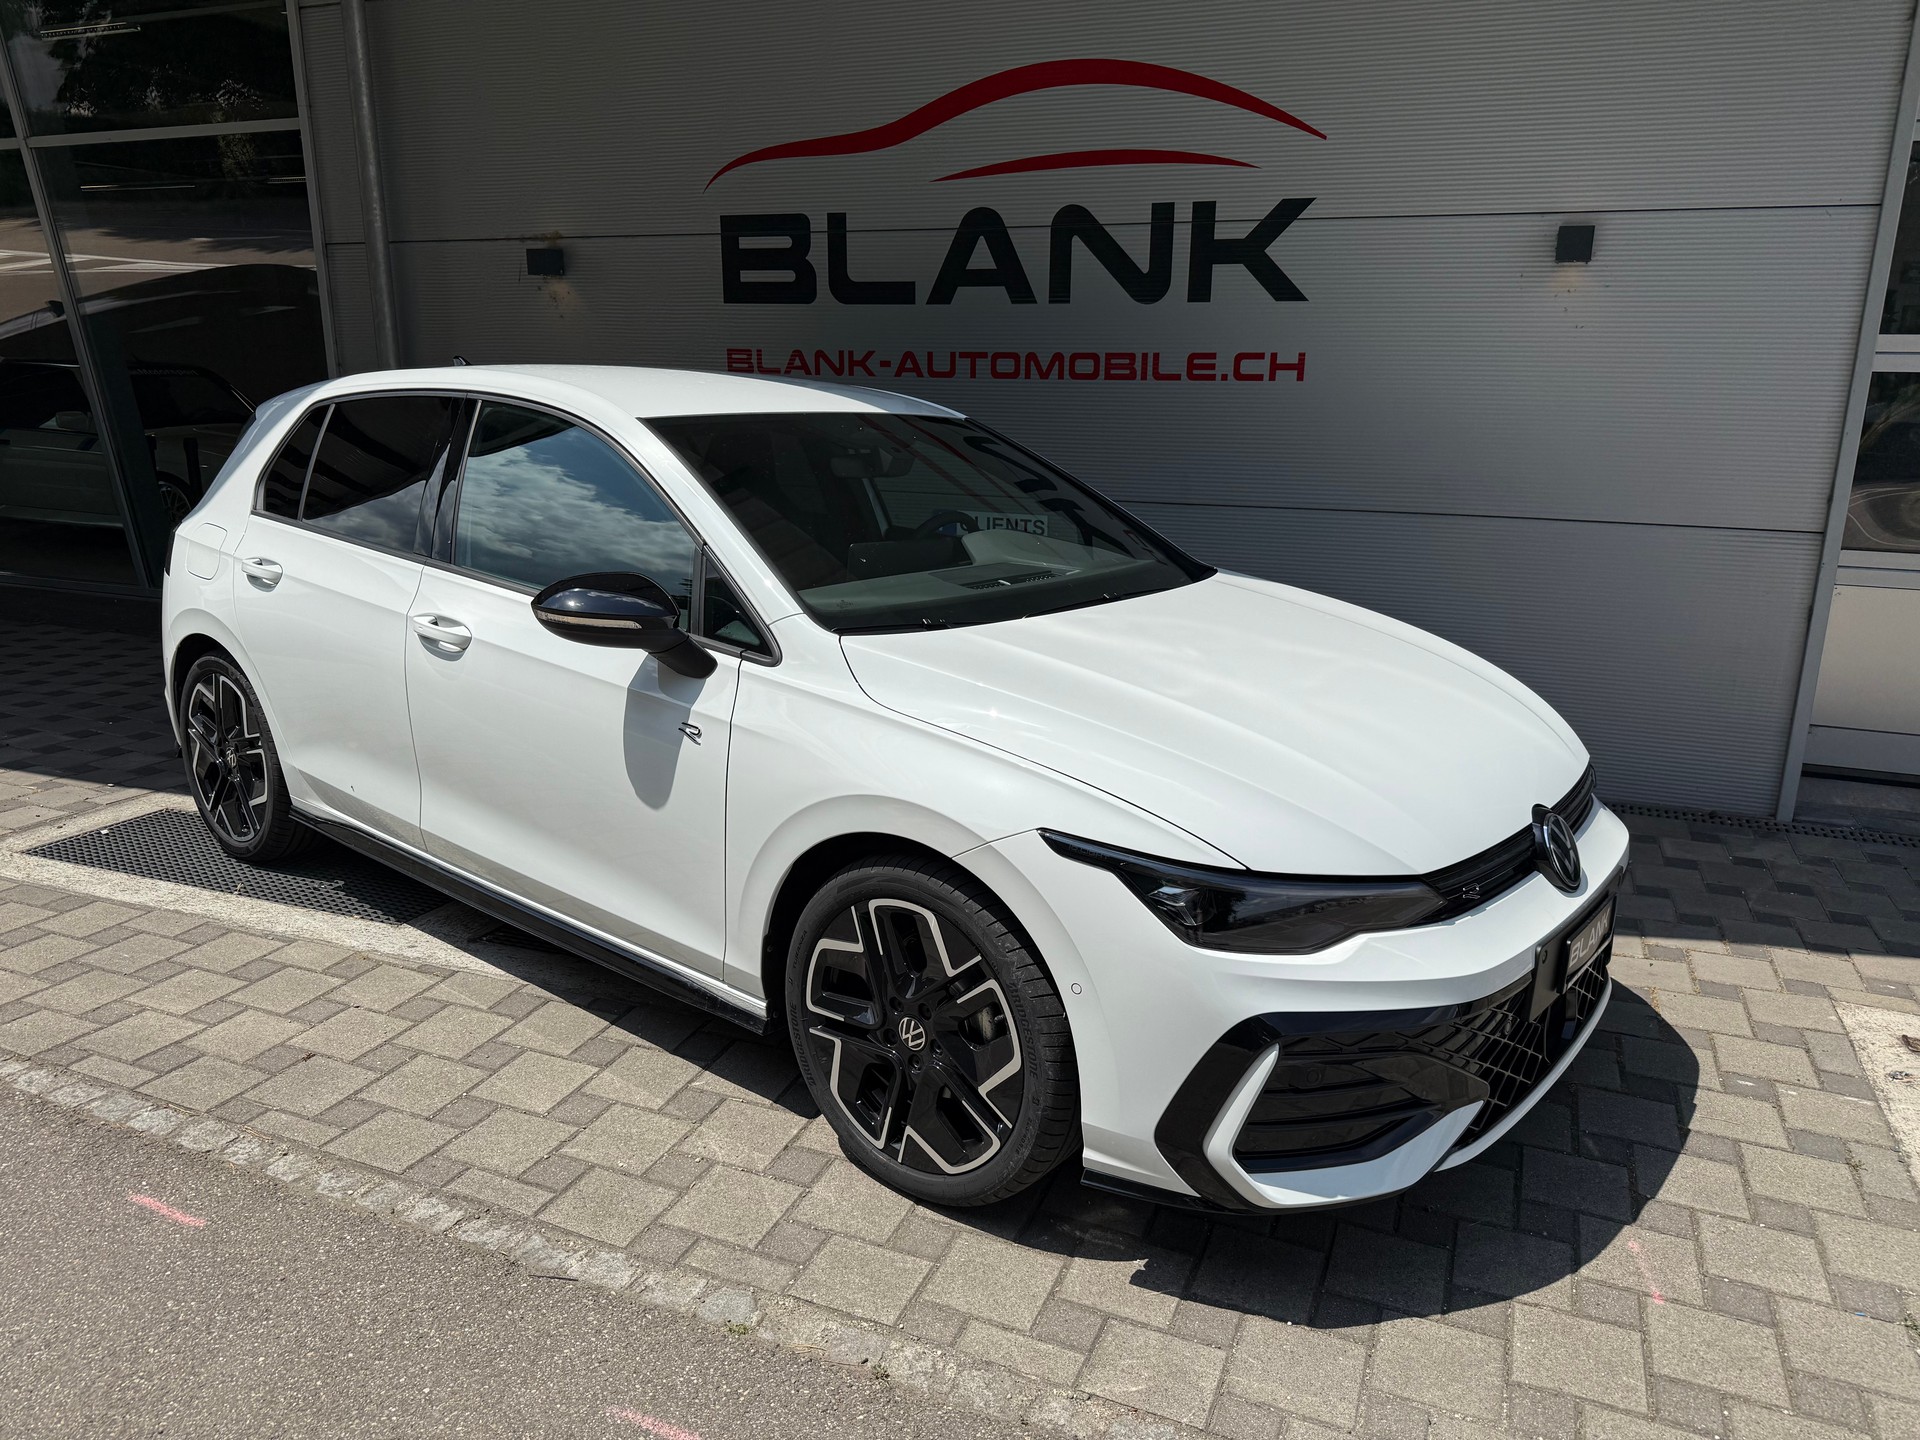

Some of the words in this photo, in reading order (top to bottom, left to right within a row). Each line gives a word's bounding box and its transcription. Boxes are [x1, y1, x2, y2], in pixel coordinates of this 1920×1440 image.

[720, 197, 1316, 305] BLANK
[727, 348, 1305, 382] BLANK-AUTOMOBILE.CH
[1569, 907, 1610, 967] BLANK
[790, 1002, 816, 1087] BRIDGESTONE
[1006, 981, 1038, 1080] BRIDGESTONE
